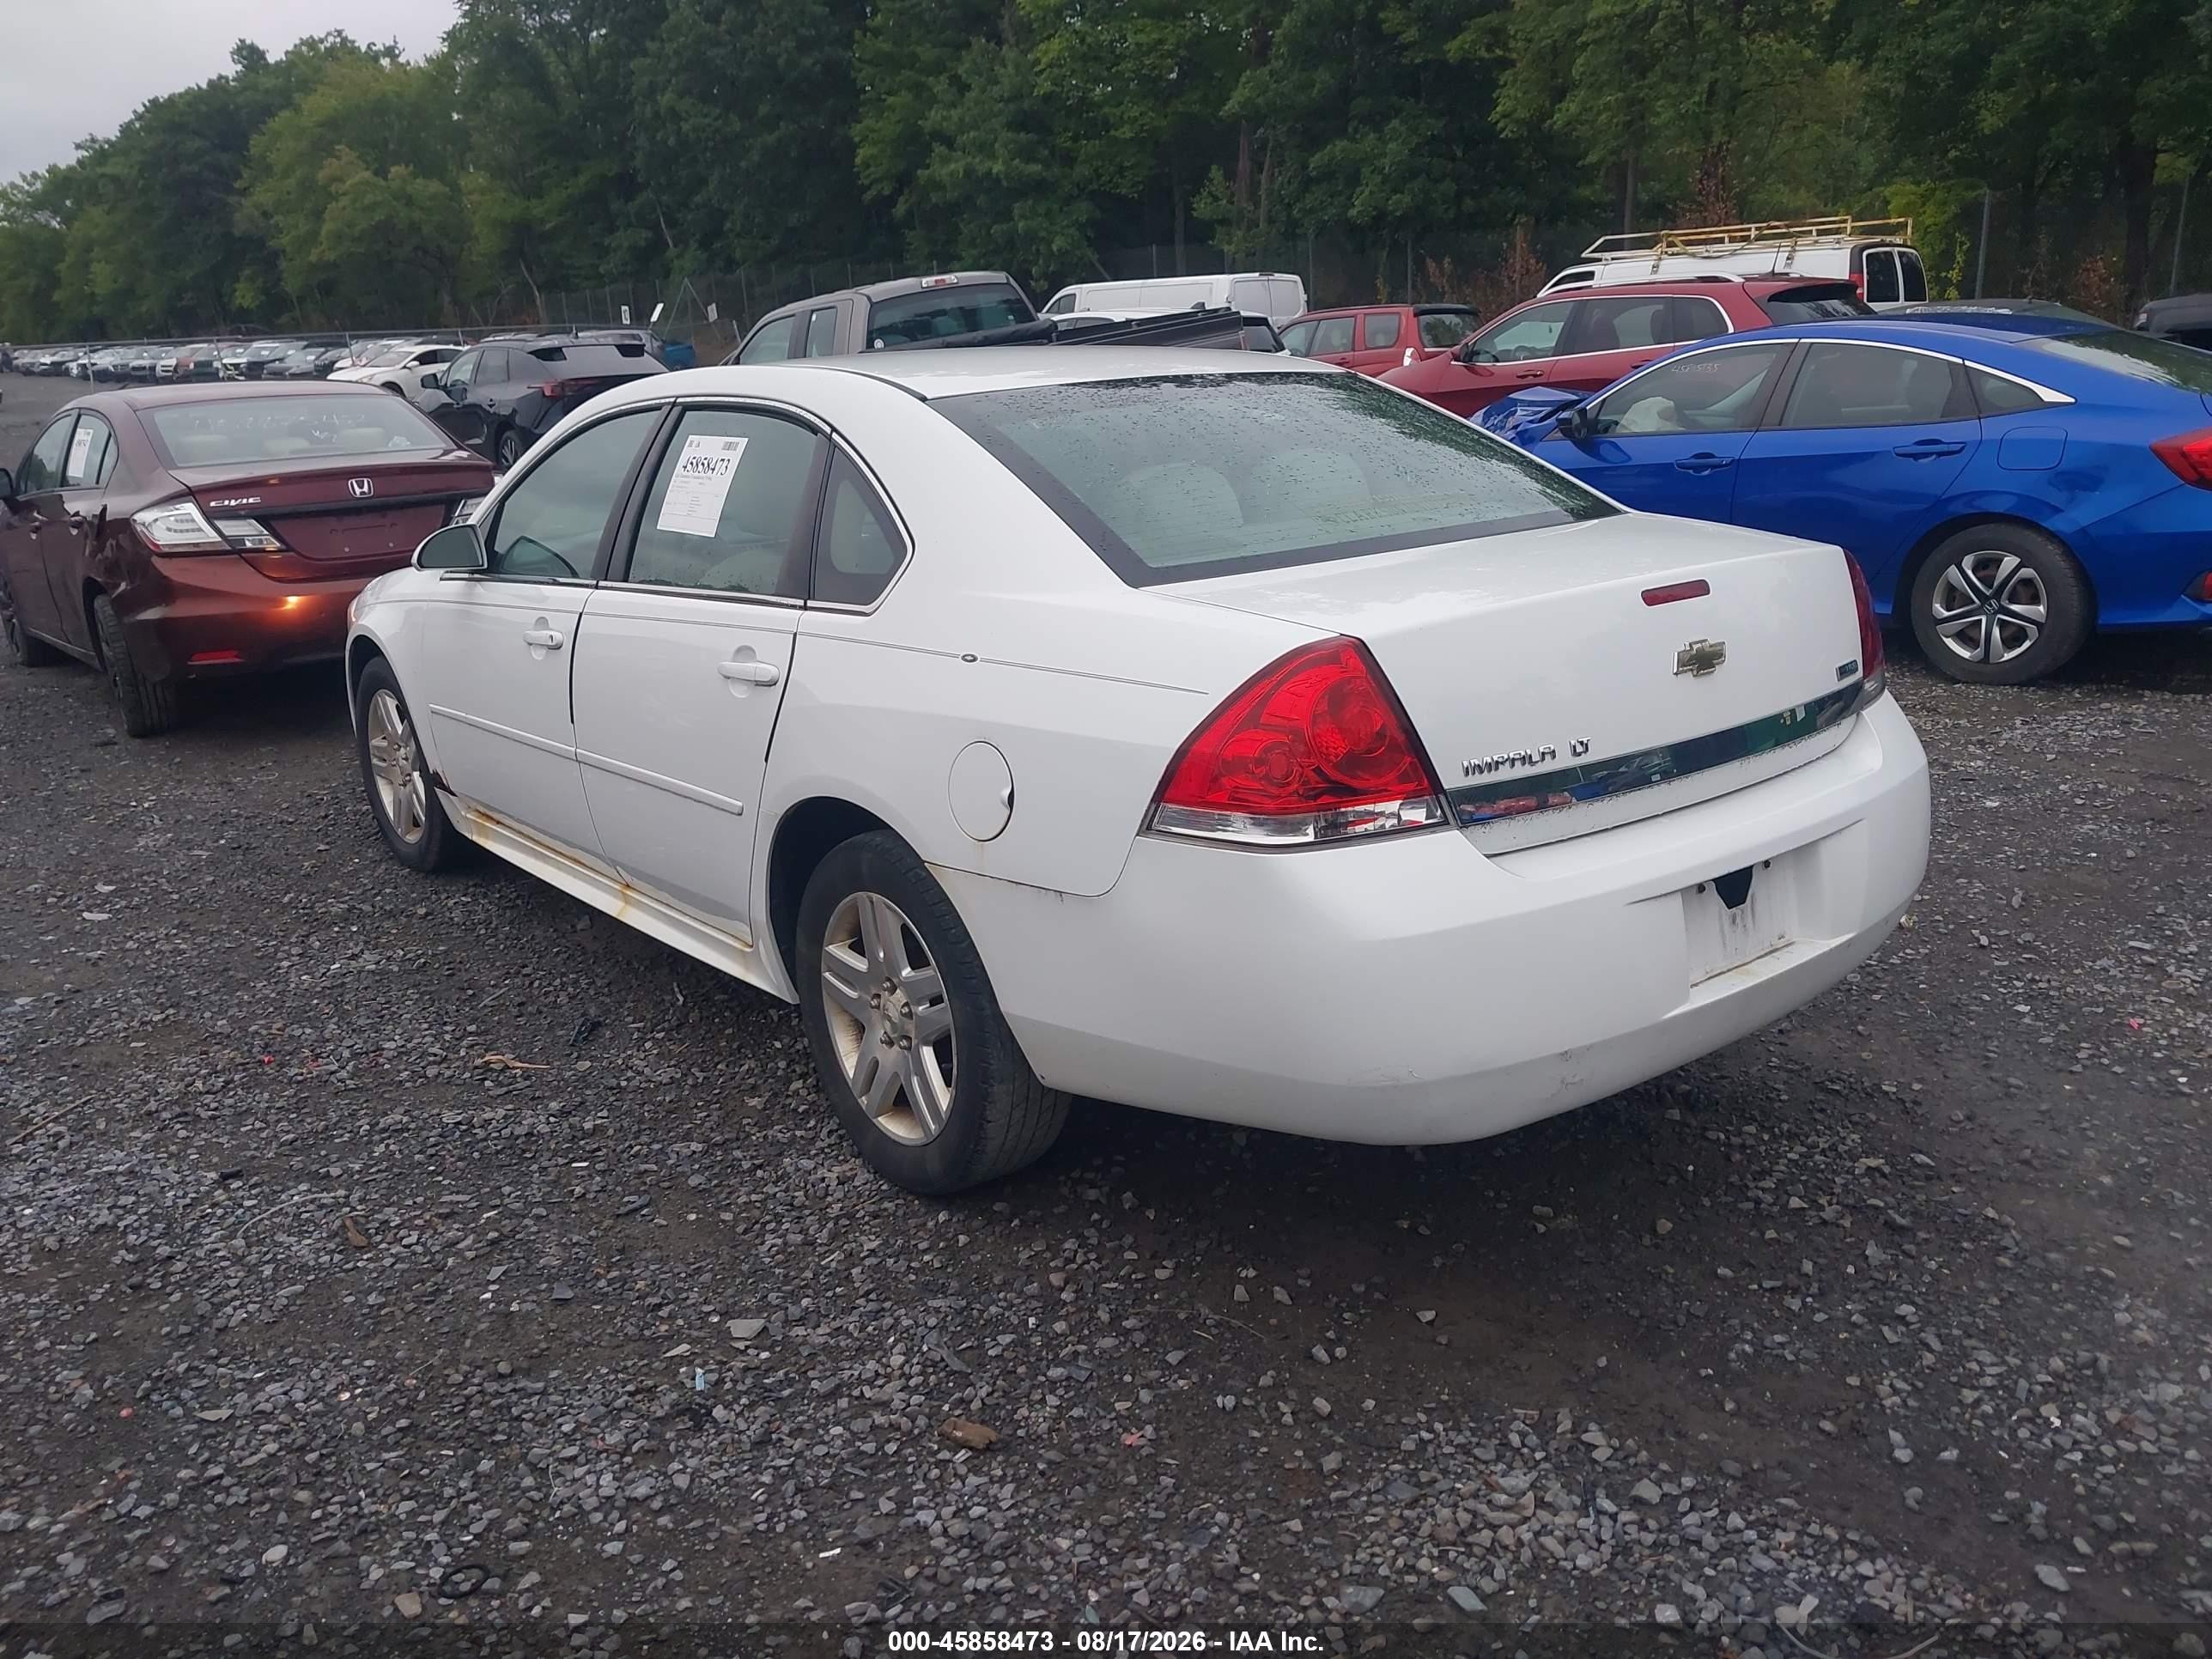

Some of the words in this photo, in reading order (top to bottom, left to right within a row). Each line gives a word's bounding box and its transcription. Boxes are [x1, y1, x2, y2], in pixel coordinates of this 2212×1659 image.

[682, 455, 731, 476] 45858473
[210, 496, 262, 507] CIVIC
[1462, 744, 1557, 777] IMPALA
[1569, 737, 1591, 757] LT
